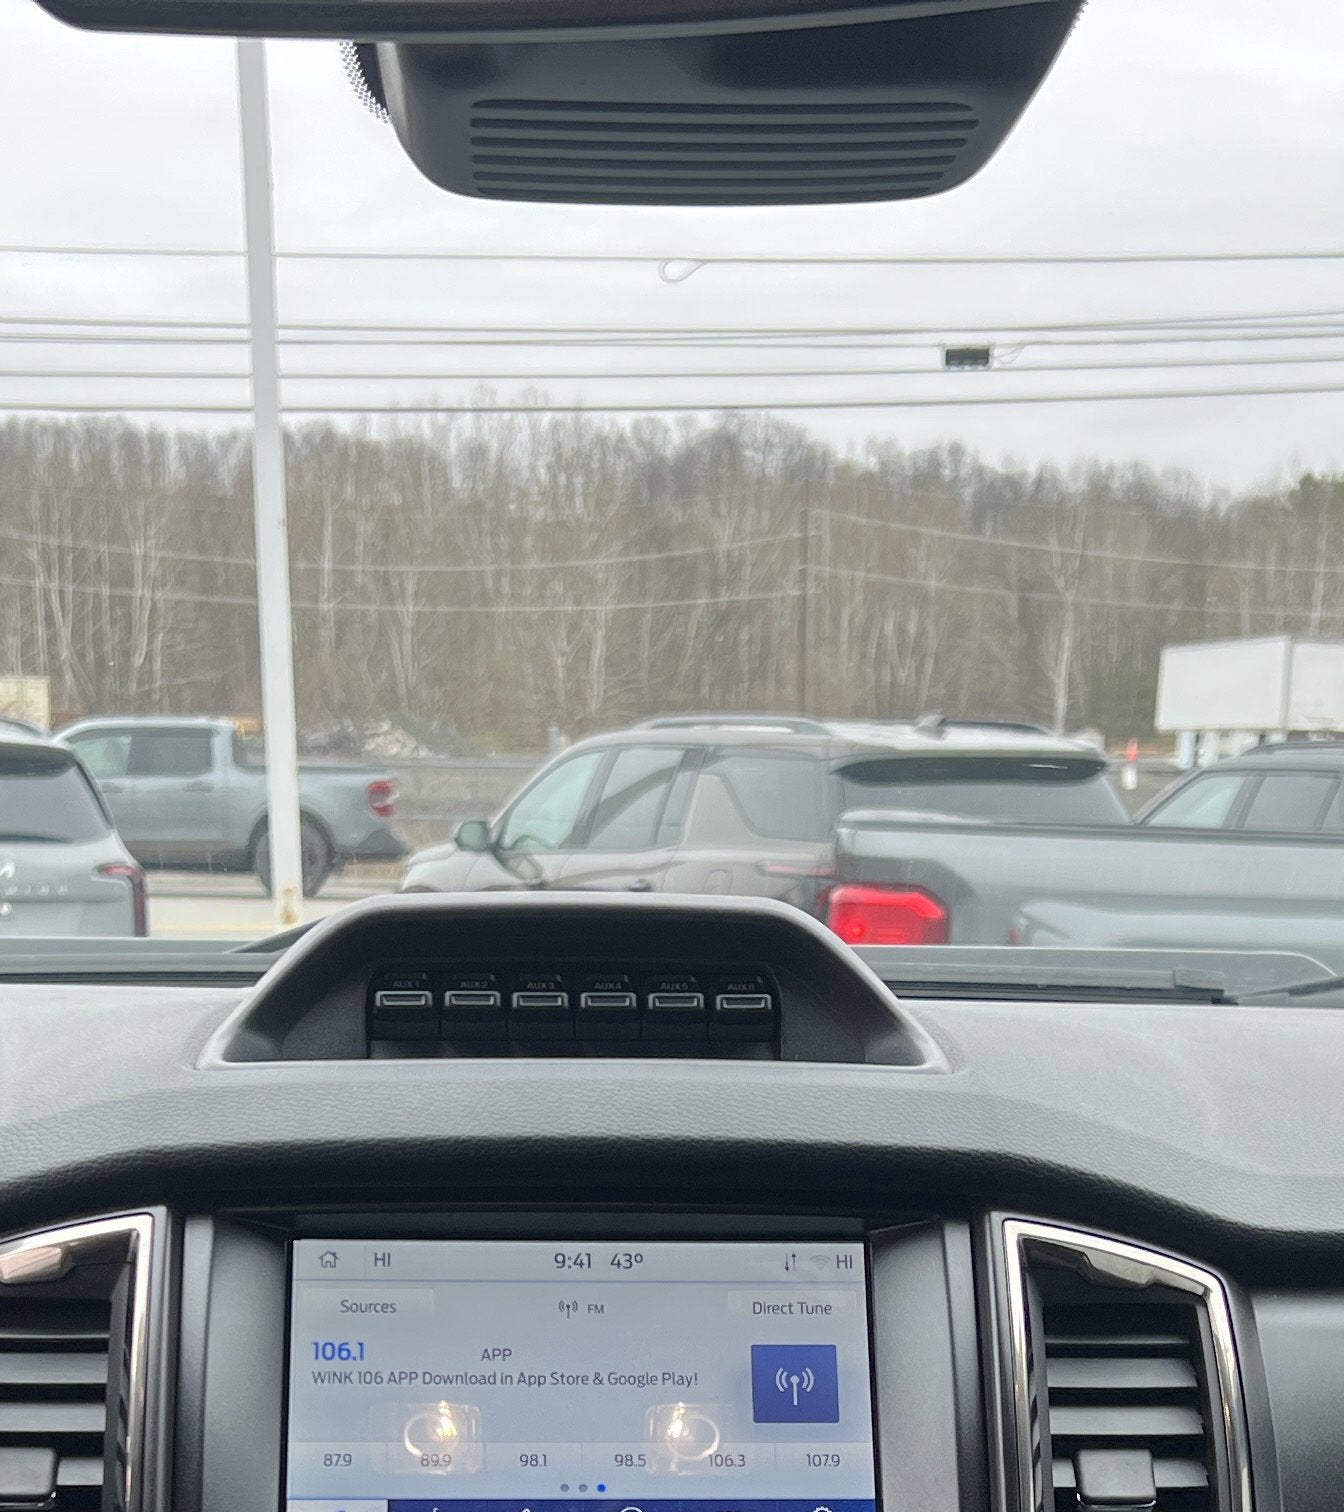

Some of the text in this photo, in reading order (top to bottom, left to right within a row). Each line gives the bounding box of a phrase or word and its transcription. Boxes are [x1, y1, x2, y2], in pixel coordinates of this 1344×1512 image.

[373, 1252, 391, 1268] HI
[554, 1253, 592, 1270] 9:41
[836, 1254, 853, 1270] HI
[340, 1299, 397, 1314] Sources
[587, 1304, 605, 1315] FM
[752, 1301, 833, 1315] Direct Tune
[312, 1341, 366, 1362] 106.1
[480, 1348, 513, 1362] APP
[311, 1371, 698, 1390] WINK 106 APP Download in App Store & Google Play!
[323, 1453, 353, 1468] 87.9
[420, 1453, 452, 1468] 89.9
[519, 1453, 548, 1468] 98.1
[614, 1453, 647, 1468] 98.5
[709, 1453, 746, 1468] 106.3
[806, 1453, 841, 1468] 107.9
